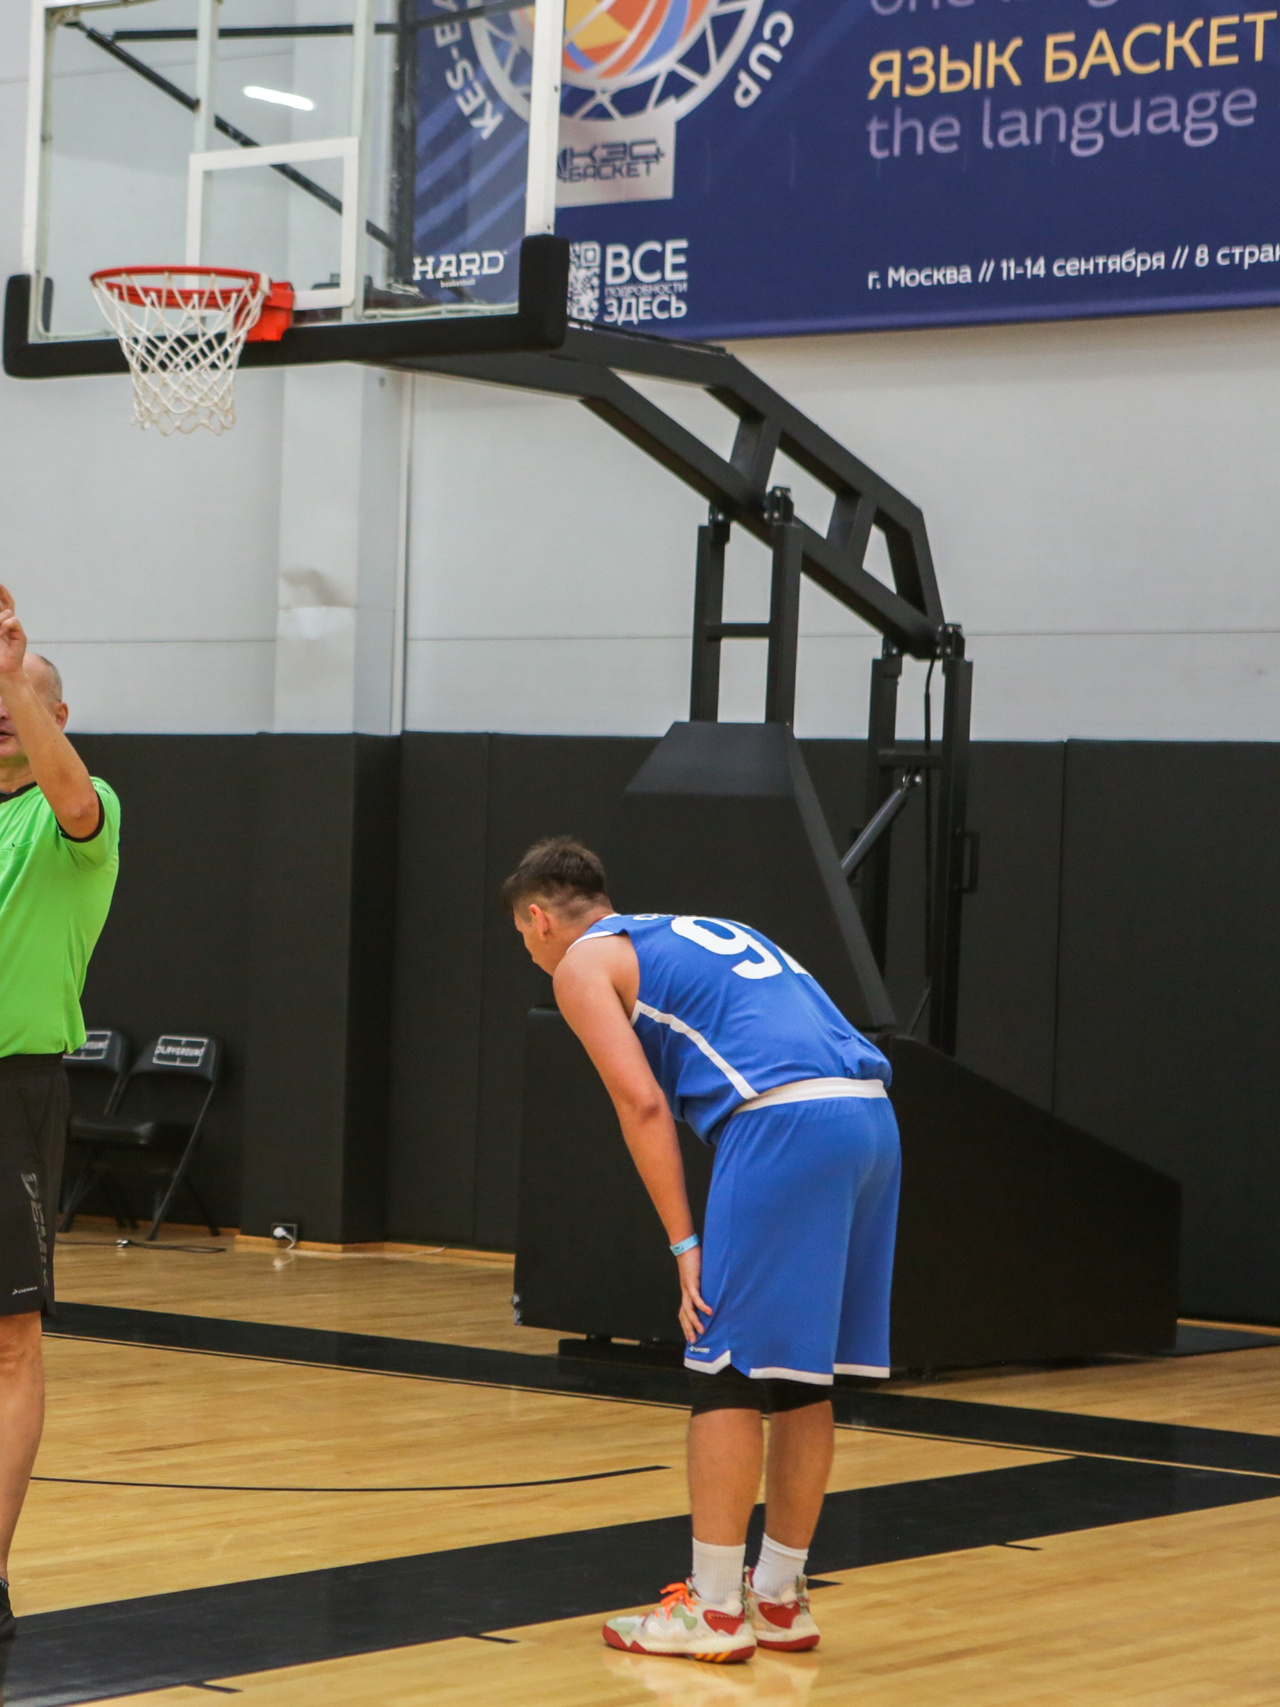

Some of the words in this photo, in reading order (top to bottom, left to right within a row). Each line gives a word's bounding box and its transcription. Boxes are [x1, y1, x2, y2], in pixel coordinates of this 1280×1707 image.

[432, 0, 505, 140] KES-B
[734, 10, 794, 108] CUP
[867, 36, 1023, 101] ЯЗЫК
[1044, 10, 1278, 84] БАСКЕТ
[866, 105, 961, 159] the
[981, 87, 1258, 157] language
[412, 249, 505, 281] HARD
[605, 239, 689, 285] ВСЕ
[868, 270, 881, 289] г.
[887, 264, 972, 289] Москва
[1001, 255, 1046, 281] 11-14
[1053, 247, 1166, 278] сентября
[1195, 243, 1209, 267] 8
[603, 294, 687, 327] ЗДЕСЬ
